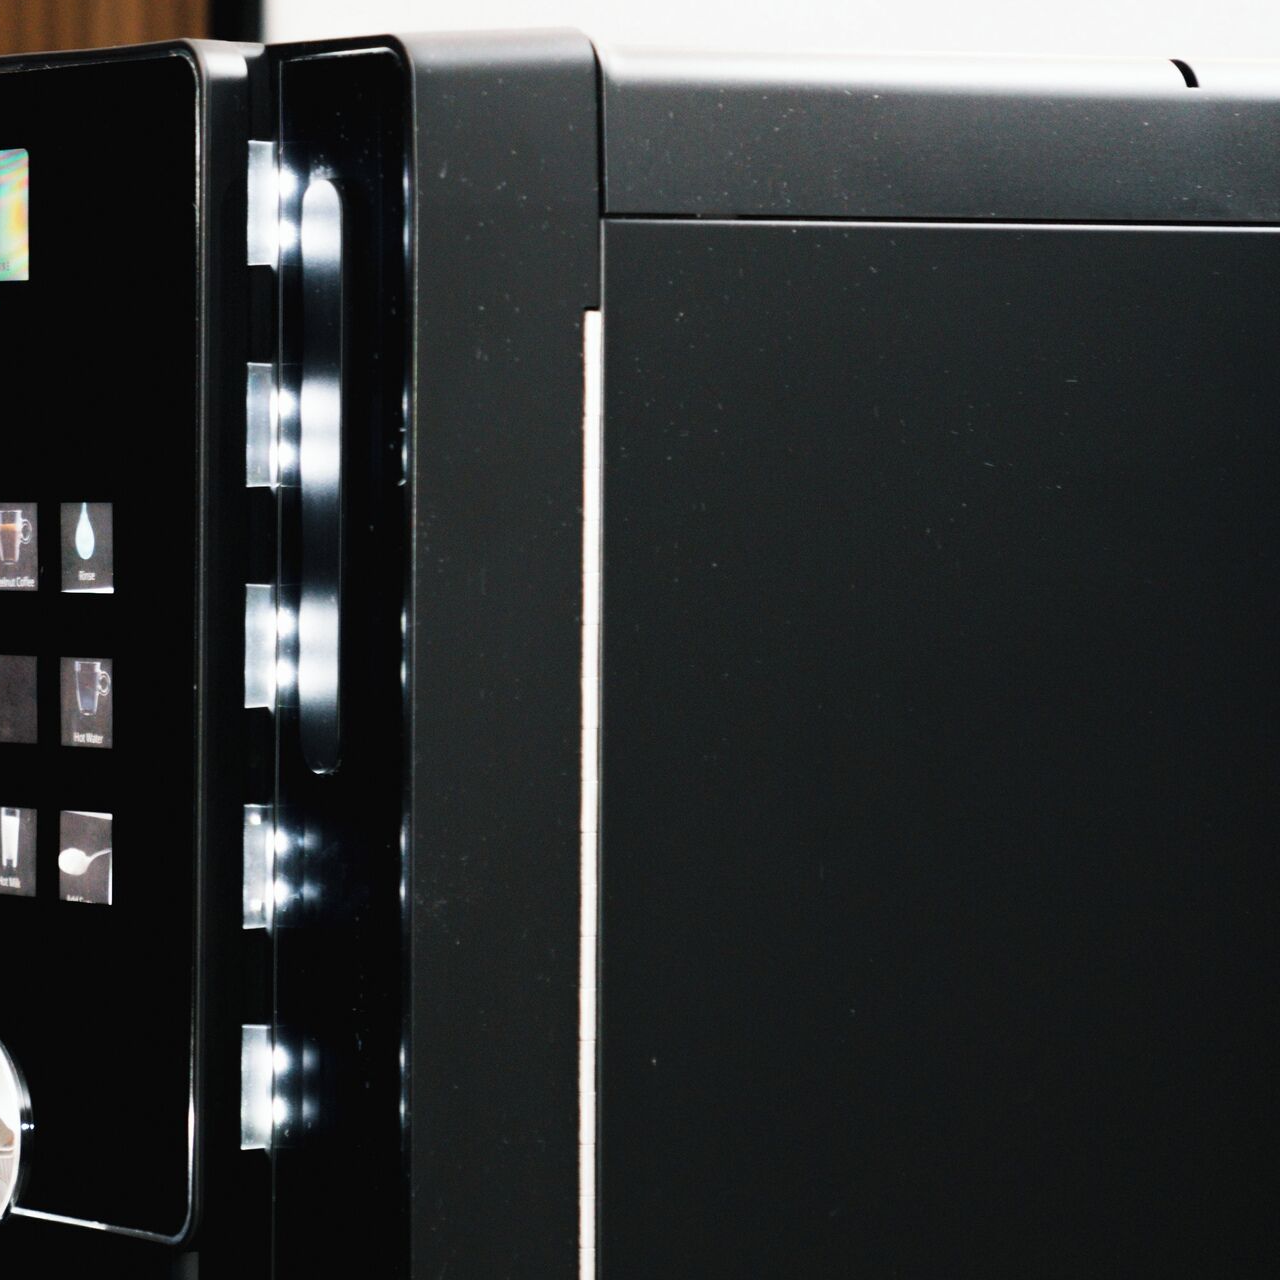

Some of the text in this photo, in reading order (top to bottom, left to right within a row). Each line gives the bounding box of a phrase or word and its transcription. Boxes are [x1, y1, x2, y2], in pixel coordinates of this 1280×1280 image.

[78, 570, 96, 581] Rinse
[16, 576, 35, 588] Coffee
[73, 732, 103, 744] Hot Water
